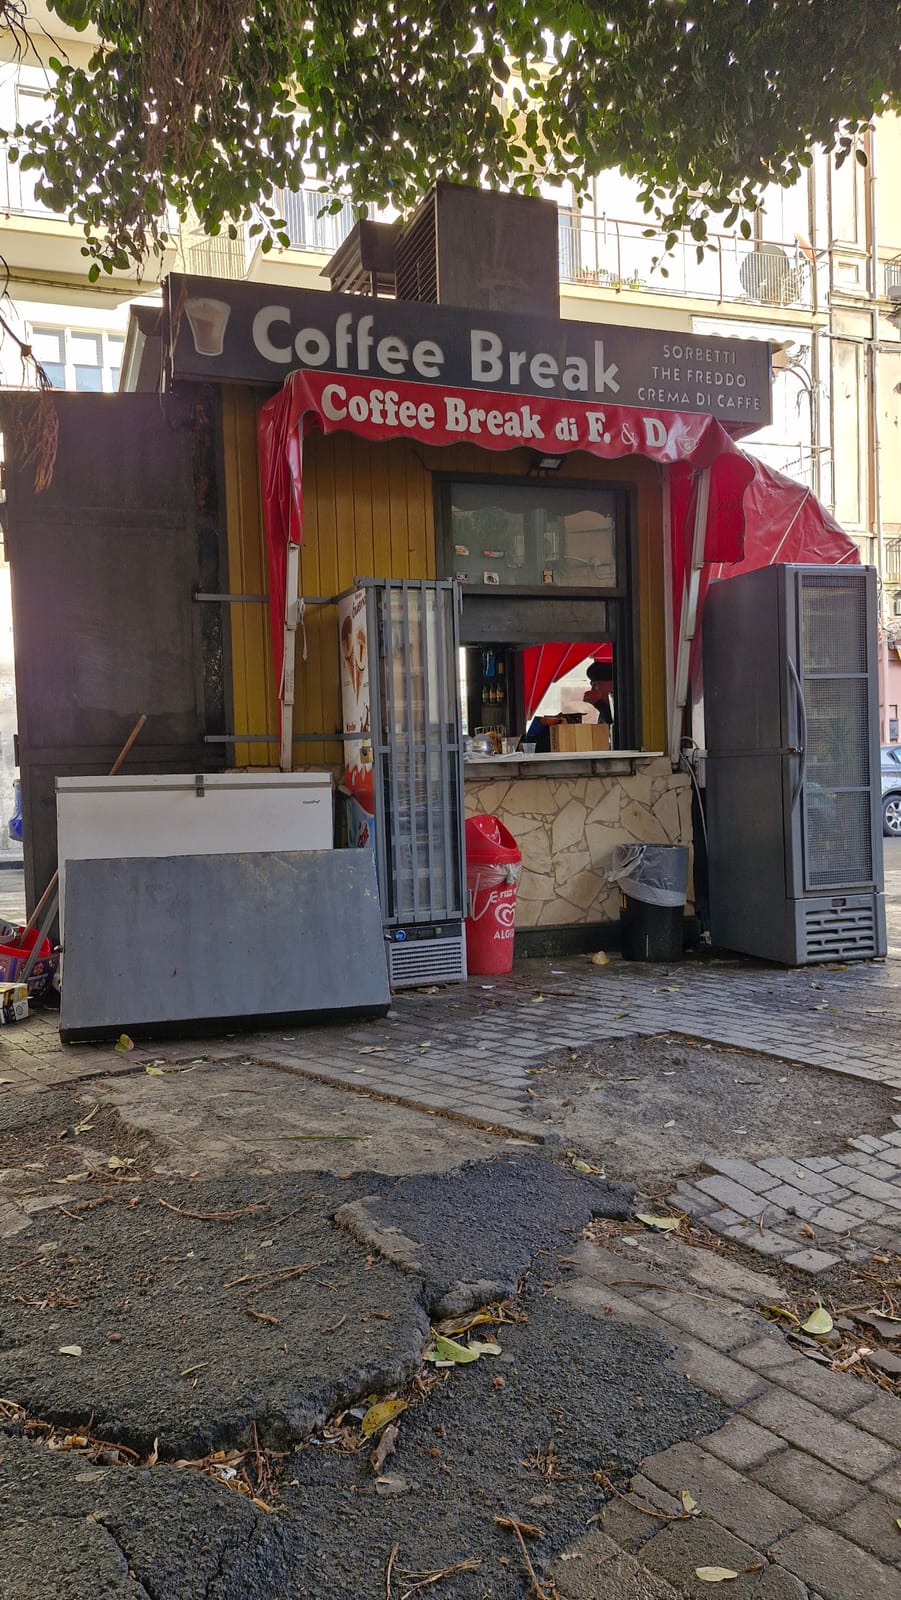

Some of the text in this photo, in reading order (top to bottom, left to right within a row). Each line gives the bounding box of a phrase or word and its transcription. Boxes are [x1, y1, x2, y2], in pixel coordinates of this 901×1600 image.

[252, 305, 621, 394] Coffee Break
[663, 344, 737, 365] SORBETTI
[687, 369, 747, 388] FREDDO
[637, 387, 690, 404] CREMA
[696, 392, 711, 407] DI
[321, 383, 435, 430] Coffee
[443, 396, 545, 439] Break
[555, 417, 579, 442] di
[585, 411, 611, 444] F.
[621, 422, 638, 447] &
